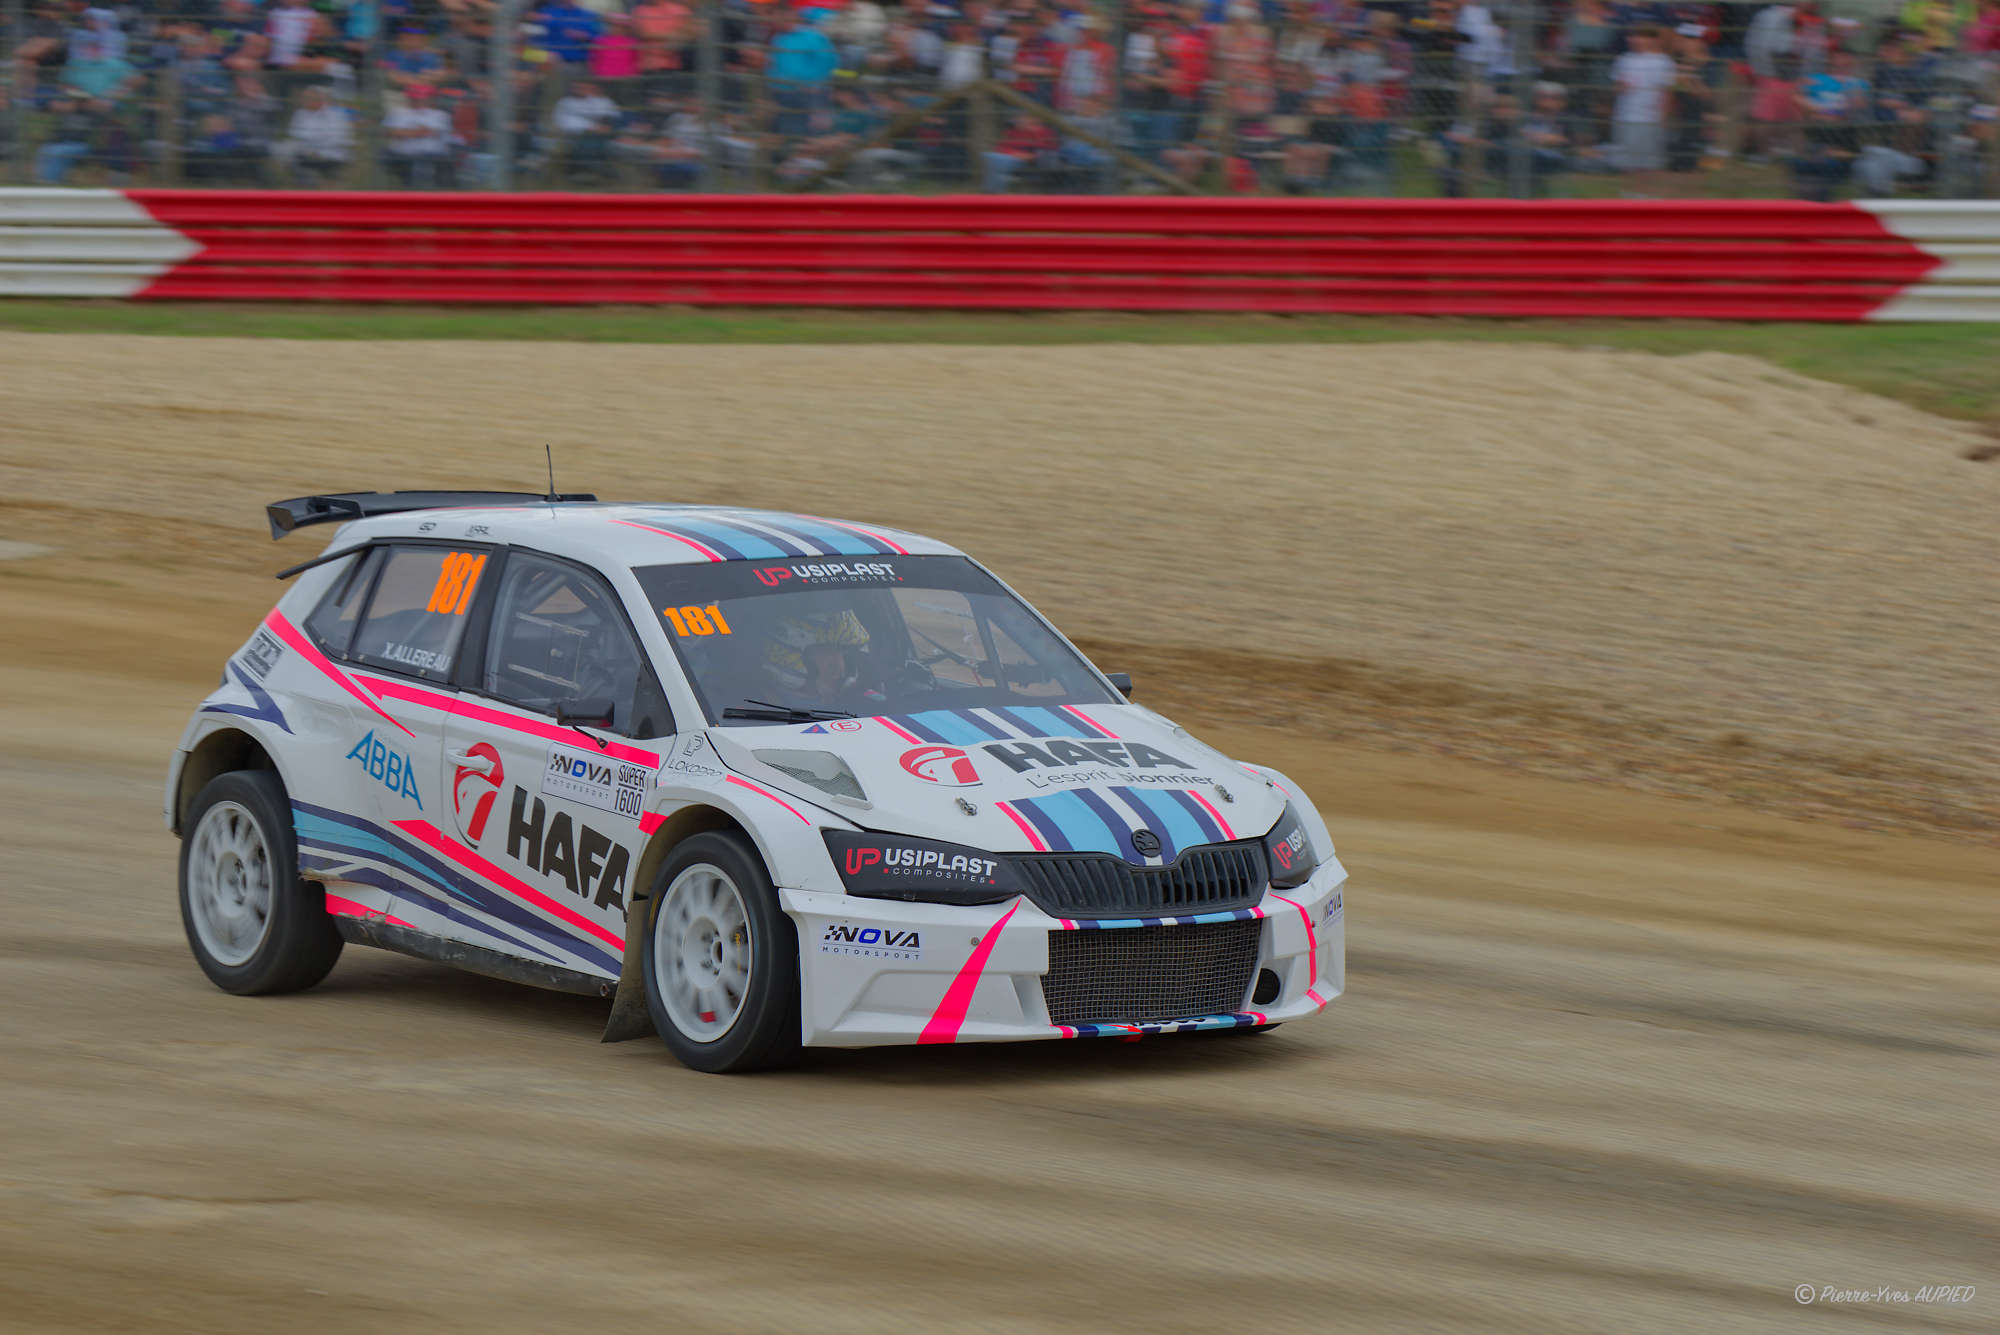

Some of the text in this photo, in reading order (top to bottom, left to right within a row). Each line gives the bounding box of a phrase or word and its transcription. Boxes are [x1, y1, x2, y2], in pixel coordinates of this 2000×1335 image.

[426, 551, 487, 615] 181
[791, 562, 895, 578] USIPLAST
[811, 576, 896, 584] COMPOSITES
[663, 604, 732, 637] 181
[381, 641, 452, 672] X.ALLEREAU
[346, 729, 423, 811] ABBA
[981, 740, 1198, 774] HAFA
[617, 764, 647, 788] SUPER
[1026, 769, 1115, 789] L'esprit
[614, 788, 643, 816] 1600
[507, 784, 631, 922] HAFA
[885, 848, 998, 876] USIPLAST
[893, 867, 986, 884] COMPOSITES
[823, 946, 921, 961] MOTORSPORT
